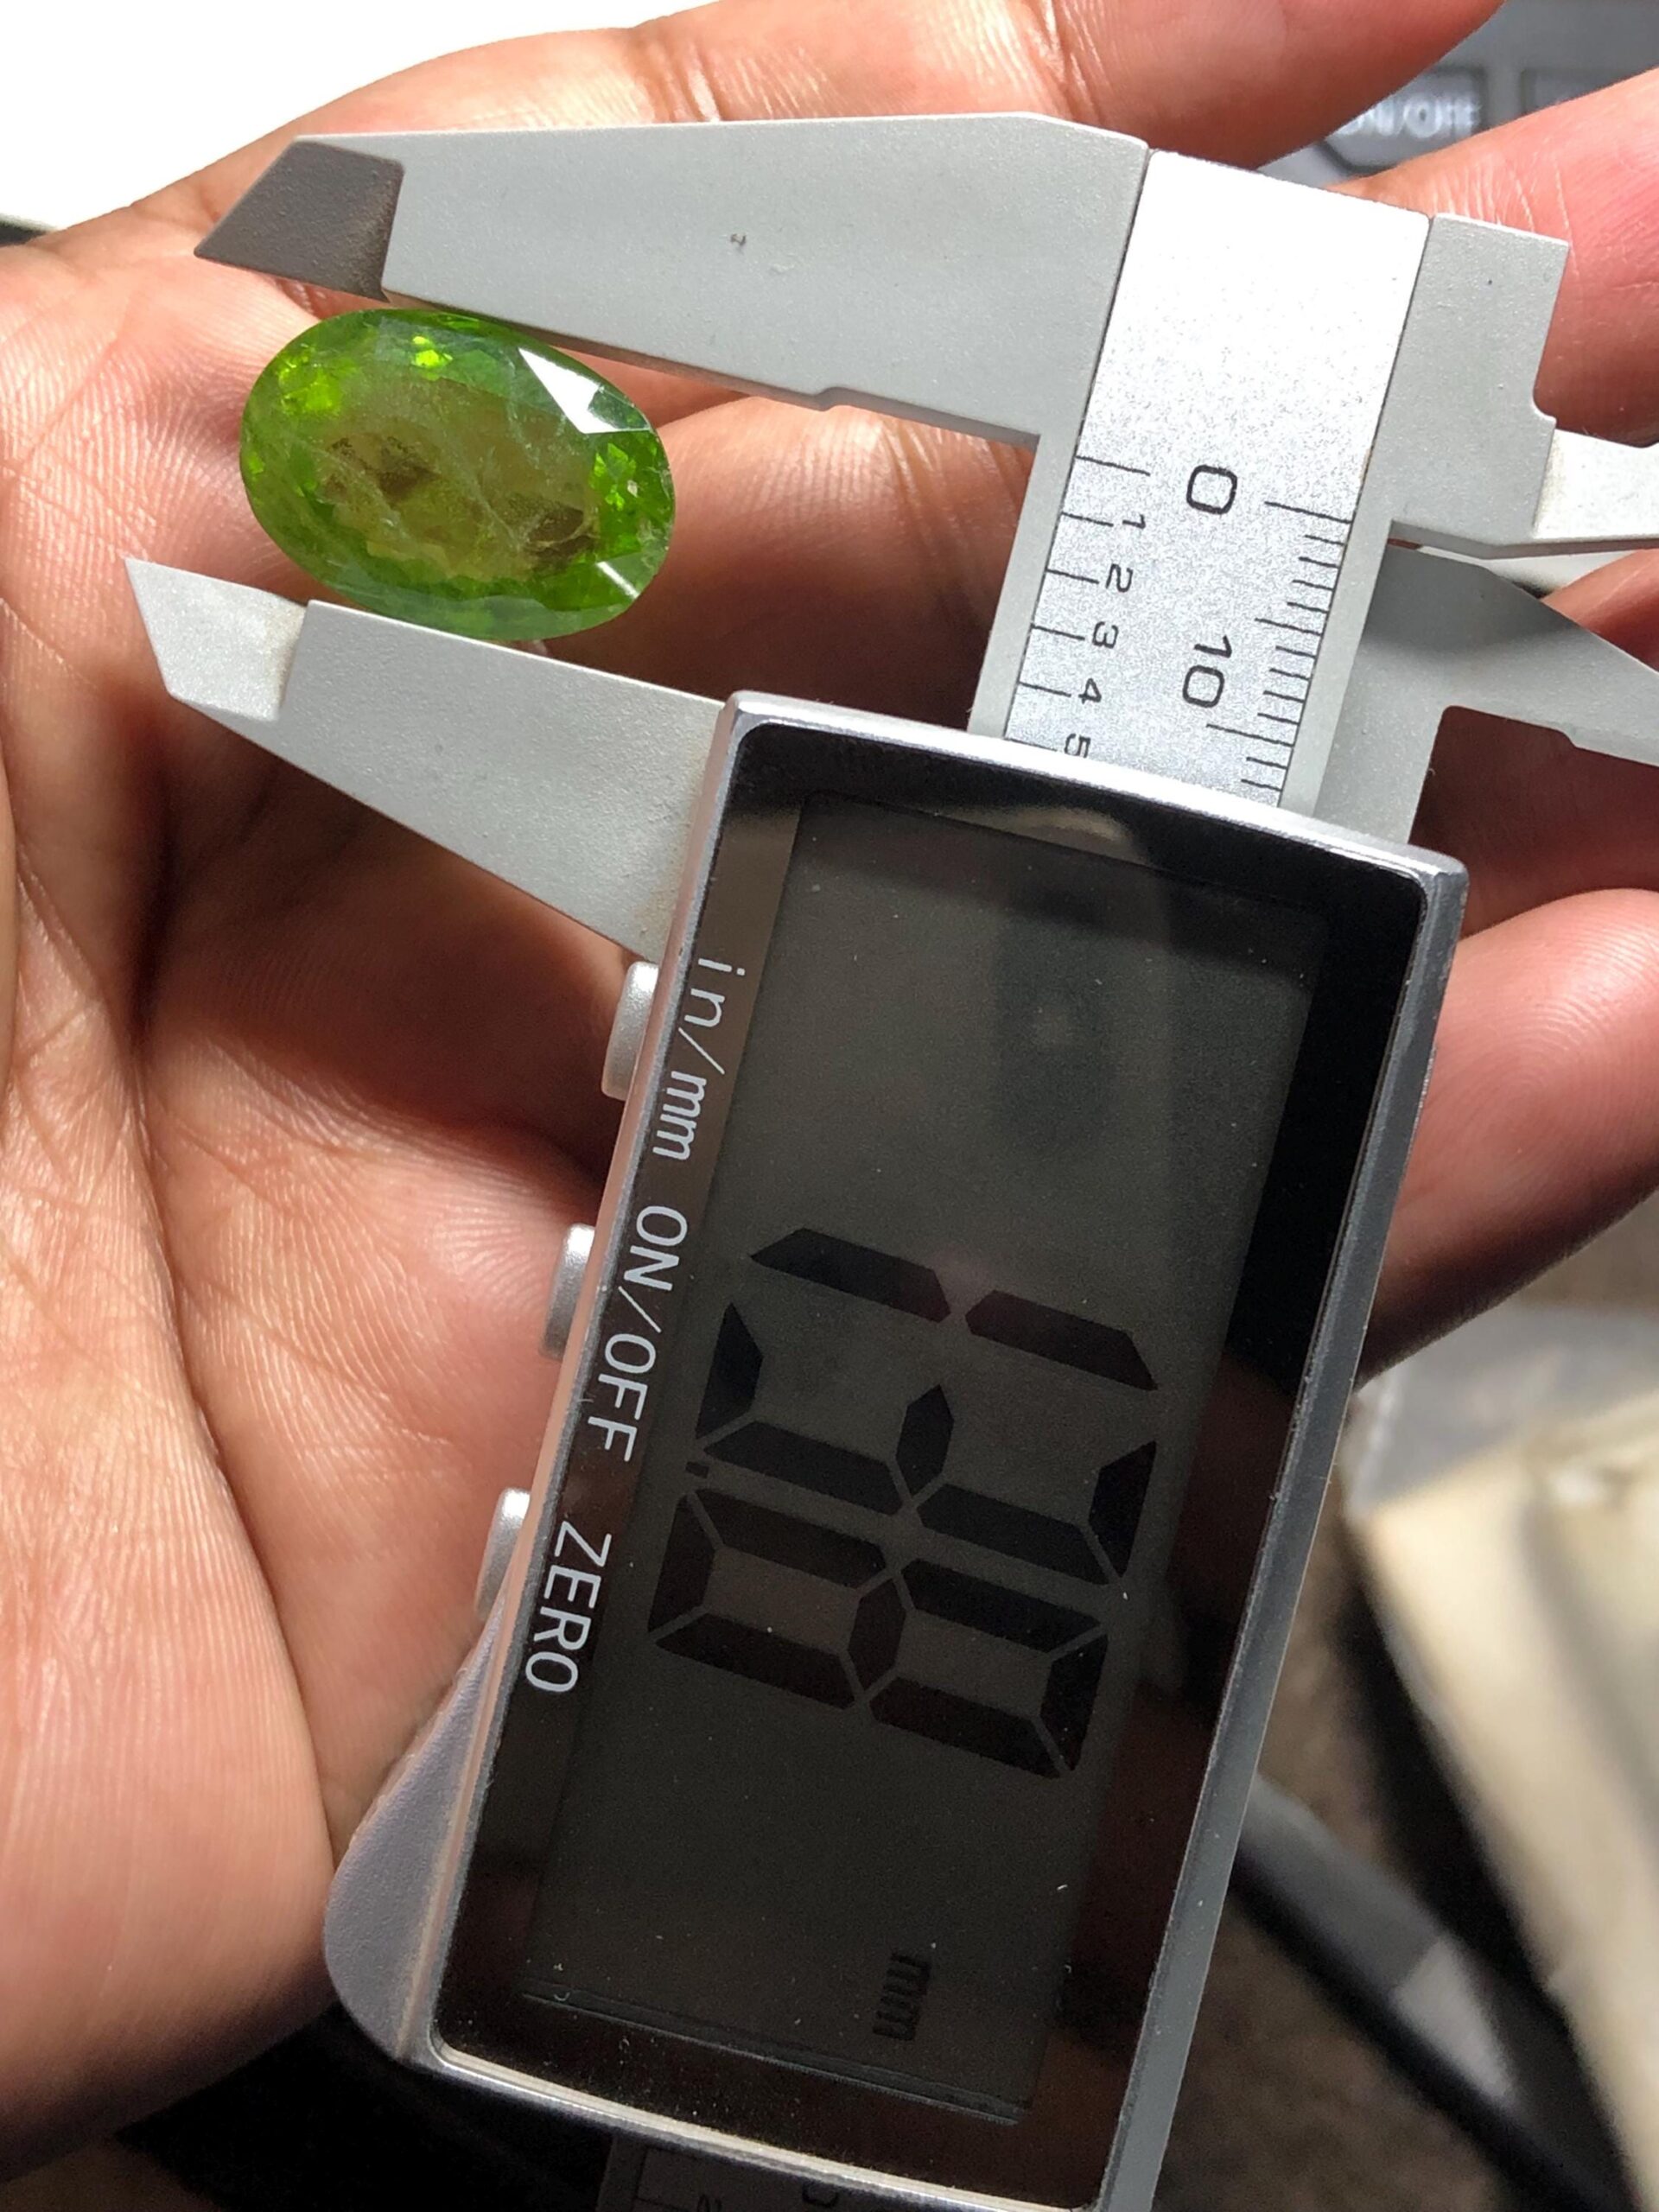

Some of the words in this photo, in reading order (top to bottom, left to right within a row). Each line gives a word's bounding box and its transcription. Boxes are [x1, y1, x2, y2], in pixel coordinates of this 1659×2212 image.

[1185, 464, 1238, 515] 0
[1122, 513, 1147, 531] 1
[1105, 563, 1134, 593] 2
[1091, 620, 1119, 650] 3
[1077, 677, 1103, 704] 4
[1182, 635, 1233, 709] 10
[1064, 733, 1091, 759] 5
[652, 957, 747, 1160] in/mm
[588, 1205, 689, 1462] ON/OFF
[646, 1227, 1159, 1779] 13.8
[524, 1520, 613, 1693] ZERO
[871, 1952, 931, 2041] mm
